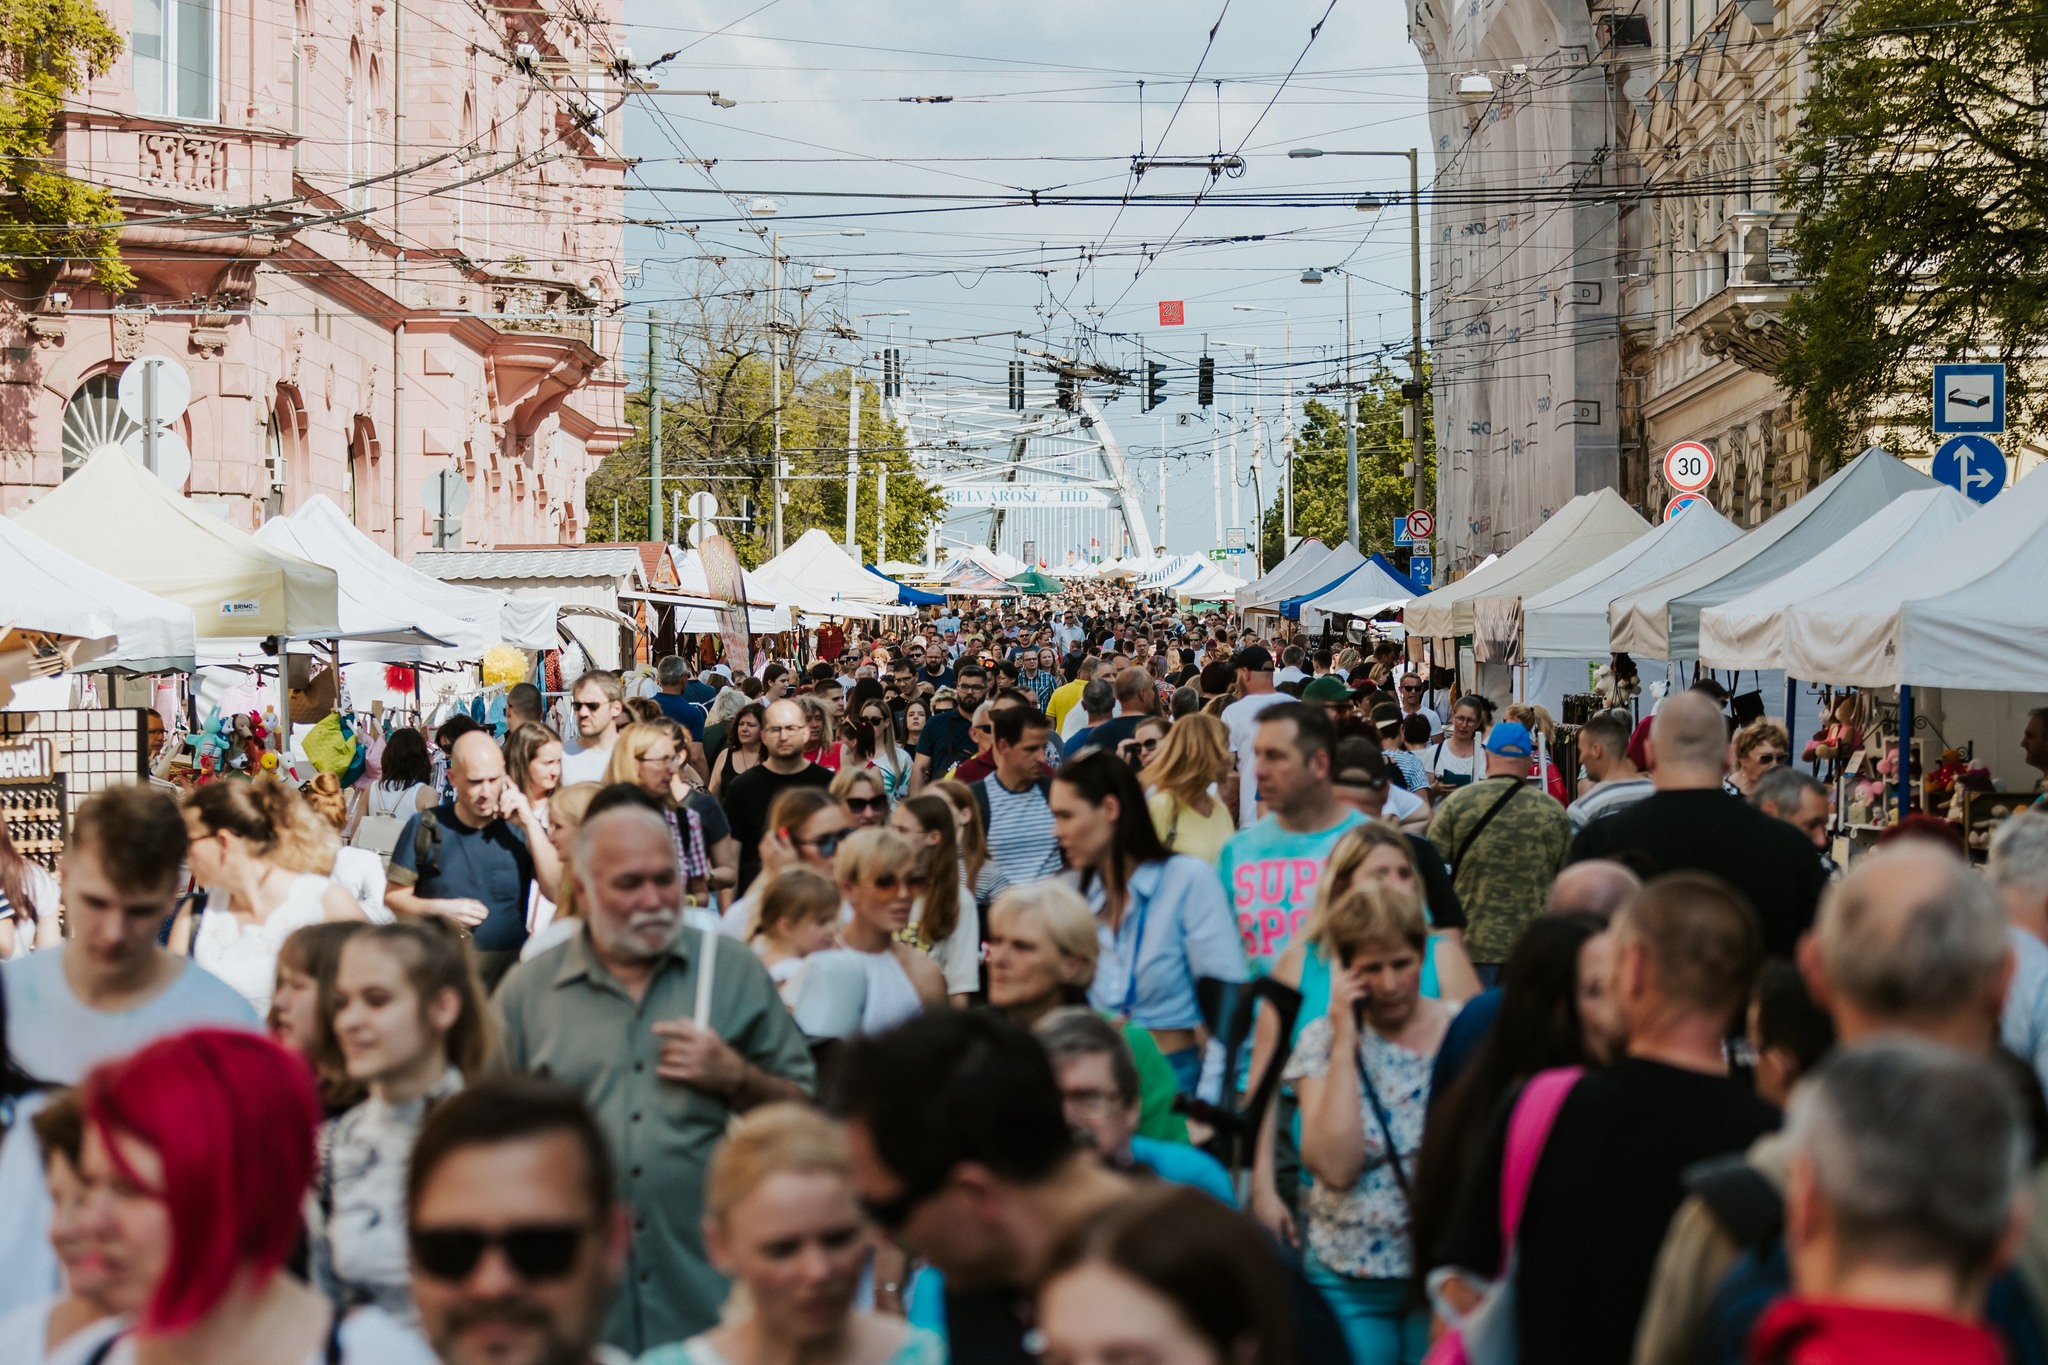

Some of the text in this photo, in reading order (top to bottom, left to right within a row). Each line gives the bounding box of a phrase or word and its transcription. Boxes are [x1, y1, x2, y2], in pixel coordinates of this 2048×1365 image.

[1163, 303, 1179, 316] 20
[1180, 414, 1187, 425] 2
[1678, 457, 1701, 476] 30
[1060, 487, 1089, 502] HÍD
[0, 740, 50, 779] eved!
[1234, 858, 1328, 906] SUP
